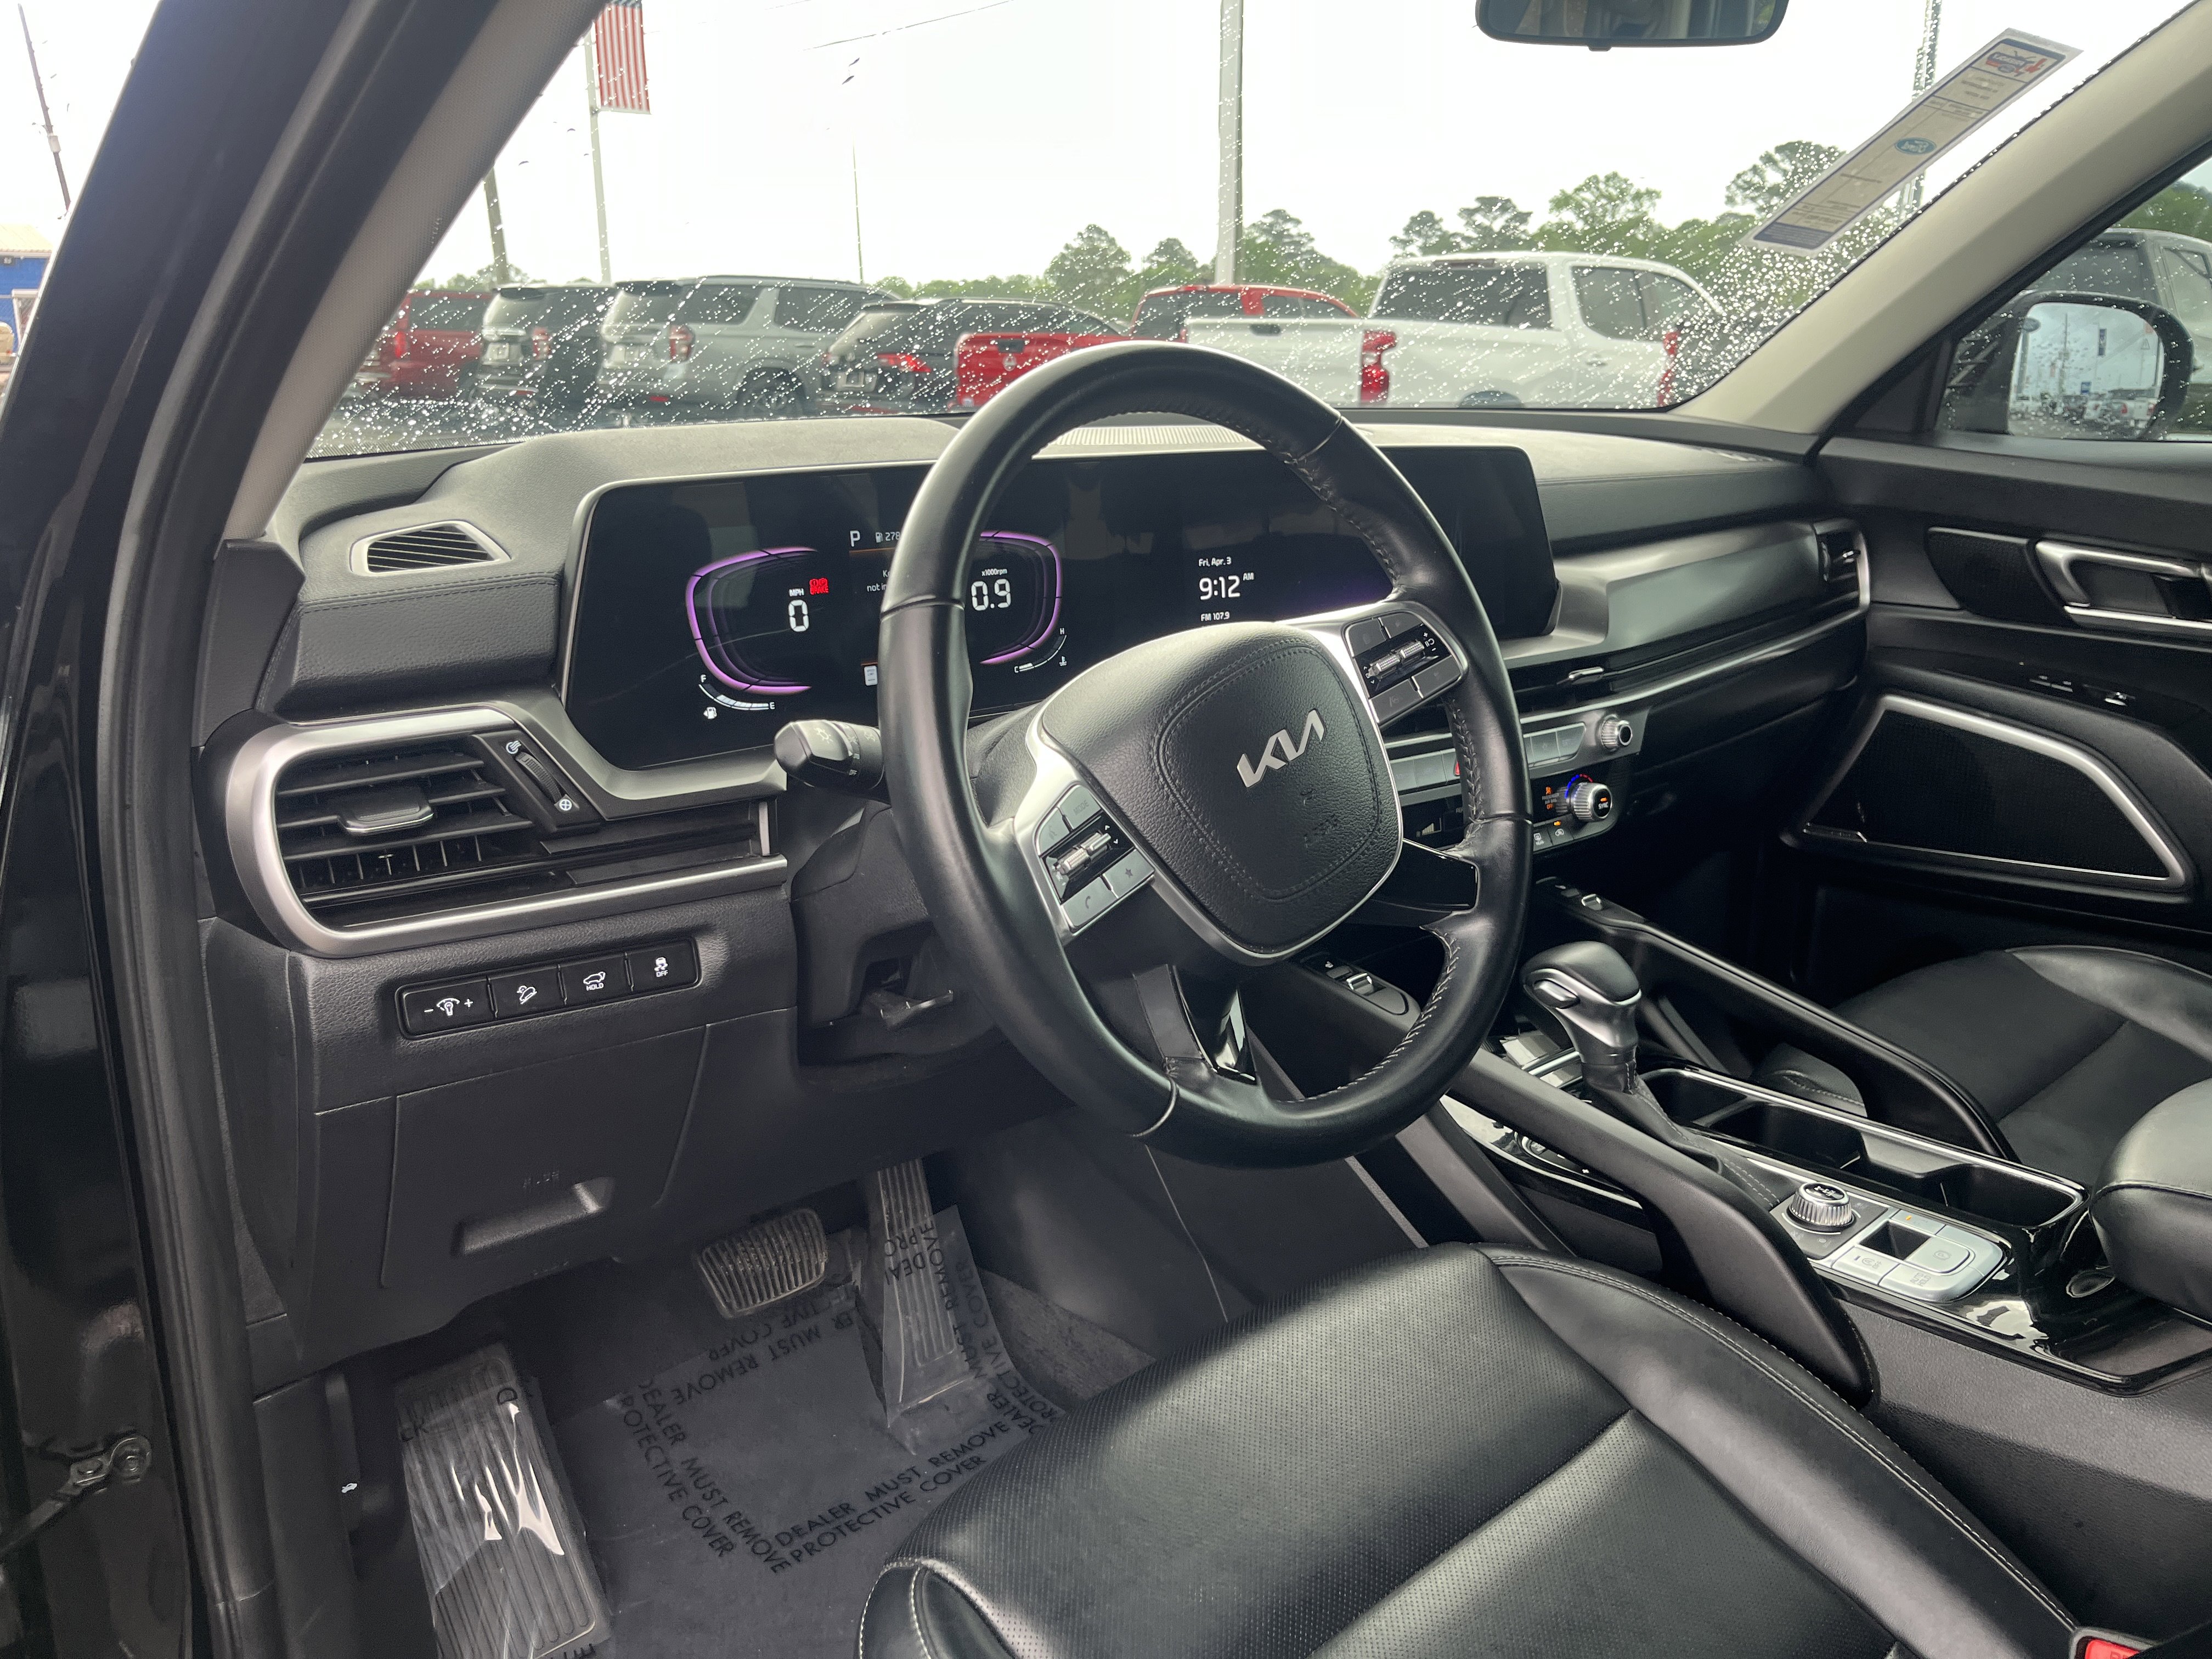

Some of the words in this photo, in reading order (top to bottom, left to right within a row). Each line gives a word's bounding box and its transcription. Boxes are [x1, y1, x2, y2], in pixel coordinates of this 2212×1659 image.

[850, 530, 860, 547] P
[981, 568, 1007, 577] x1000rpm
[1211, 557, 1226, 567] Apr.
[1226, 556, 1232, 565] 3
[789, 588, 804, 597] MPH
[867, 584, 881, 592] not
[971, 578, 1011, 611] 0.9
[1199, 575, 1240, 600] 9:12
[1243, 572, 1255, 580] AM
[788, 599, 810, 632] 0
[1201, 613, 1211, 622] FM
[1212, 611, 1230, 620] 107.9
[700, 675, 707, 683] F
[769, 702, 775, 710] E
[1237, 709, 1325, 788] KIA
[1074, 800, 1090, 815] MODE
[586, 982, 603, 991] HOLD
[768, 1325, 821, 1361] MUST
[671, 1354, 759, 1404] REMOVE
[775, 1502, 856, 1547] DEALER
[865, 1465, 922, 1502] MUST
[928, 1421, 1010, 1468] REMOVE
[681, 1457, 729, 1508] MUST
[723, 1511, 792, 1573] REMOVE
[790, 1491, 916, 1563] PROTECTIVE
[919, 1454, 987, 1493] COVER
[682, 1505, 735, 1557] COVER
